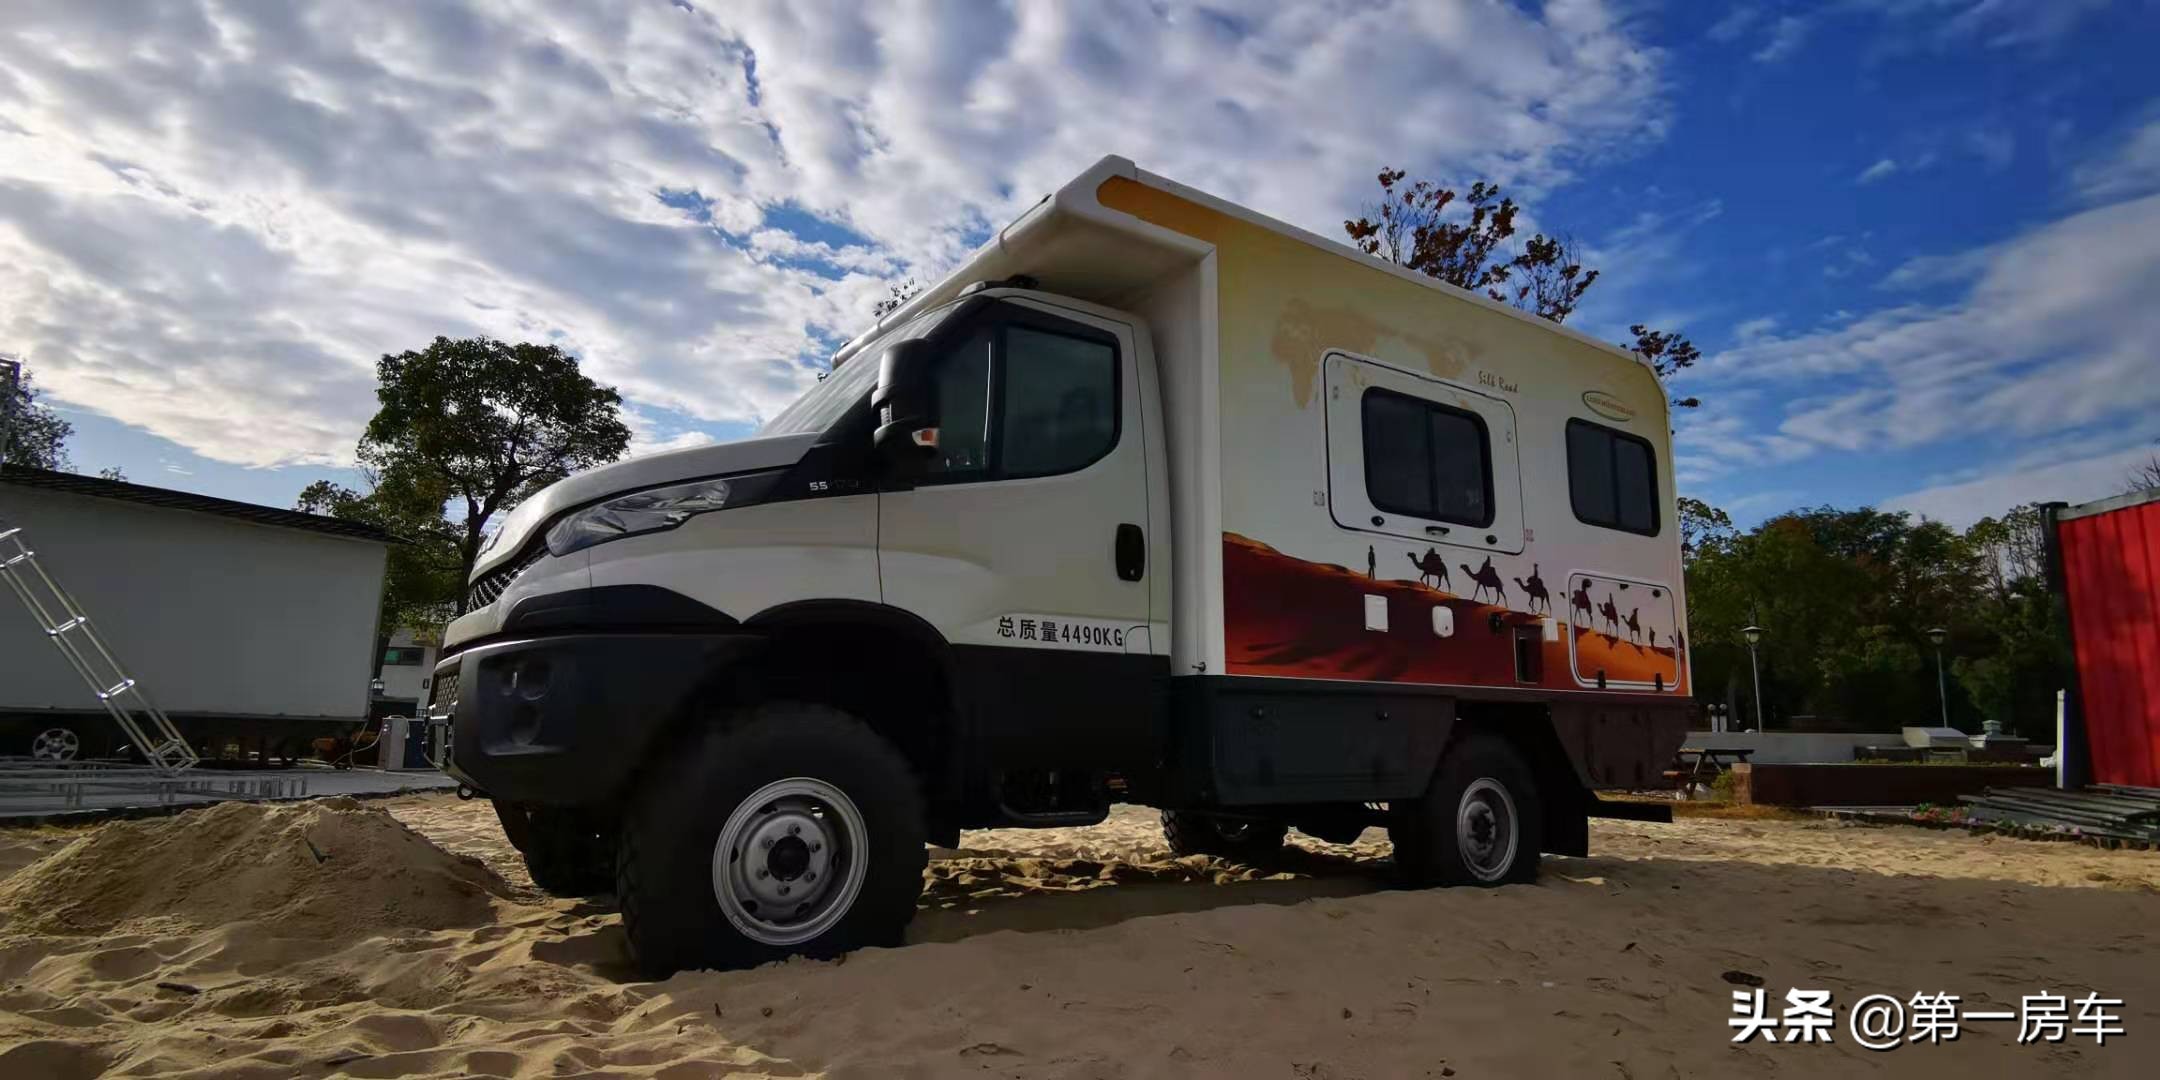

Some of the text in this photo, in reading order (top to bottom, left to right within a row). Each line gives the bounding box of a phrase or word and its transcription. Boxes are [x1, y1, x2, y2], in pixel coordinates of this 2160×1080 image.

[1478, 369, 1497, 387] Silk
[997, 616, 1124, 646] 总质量4490KG
